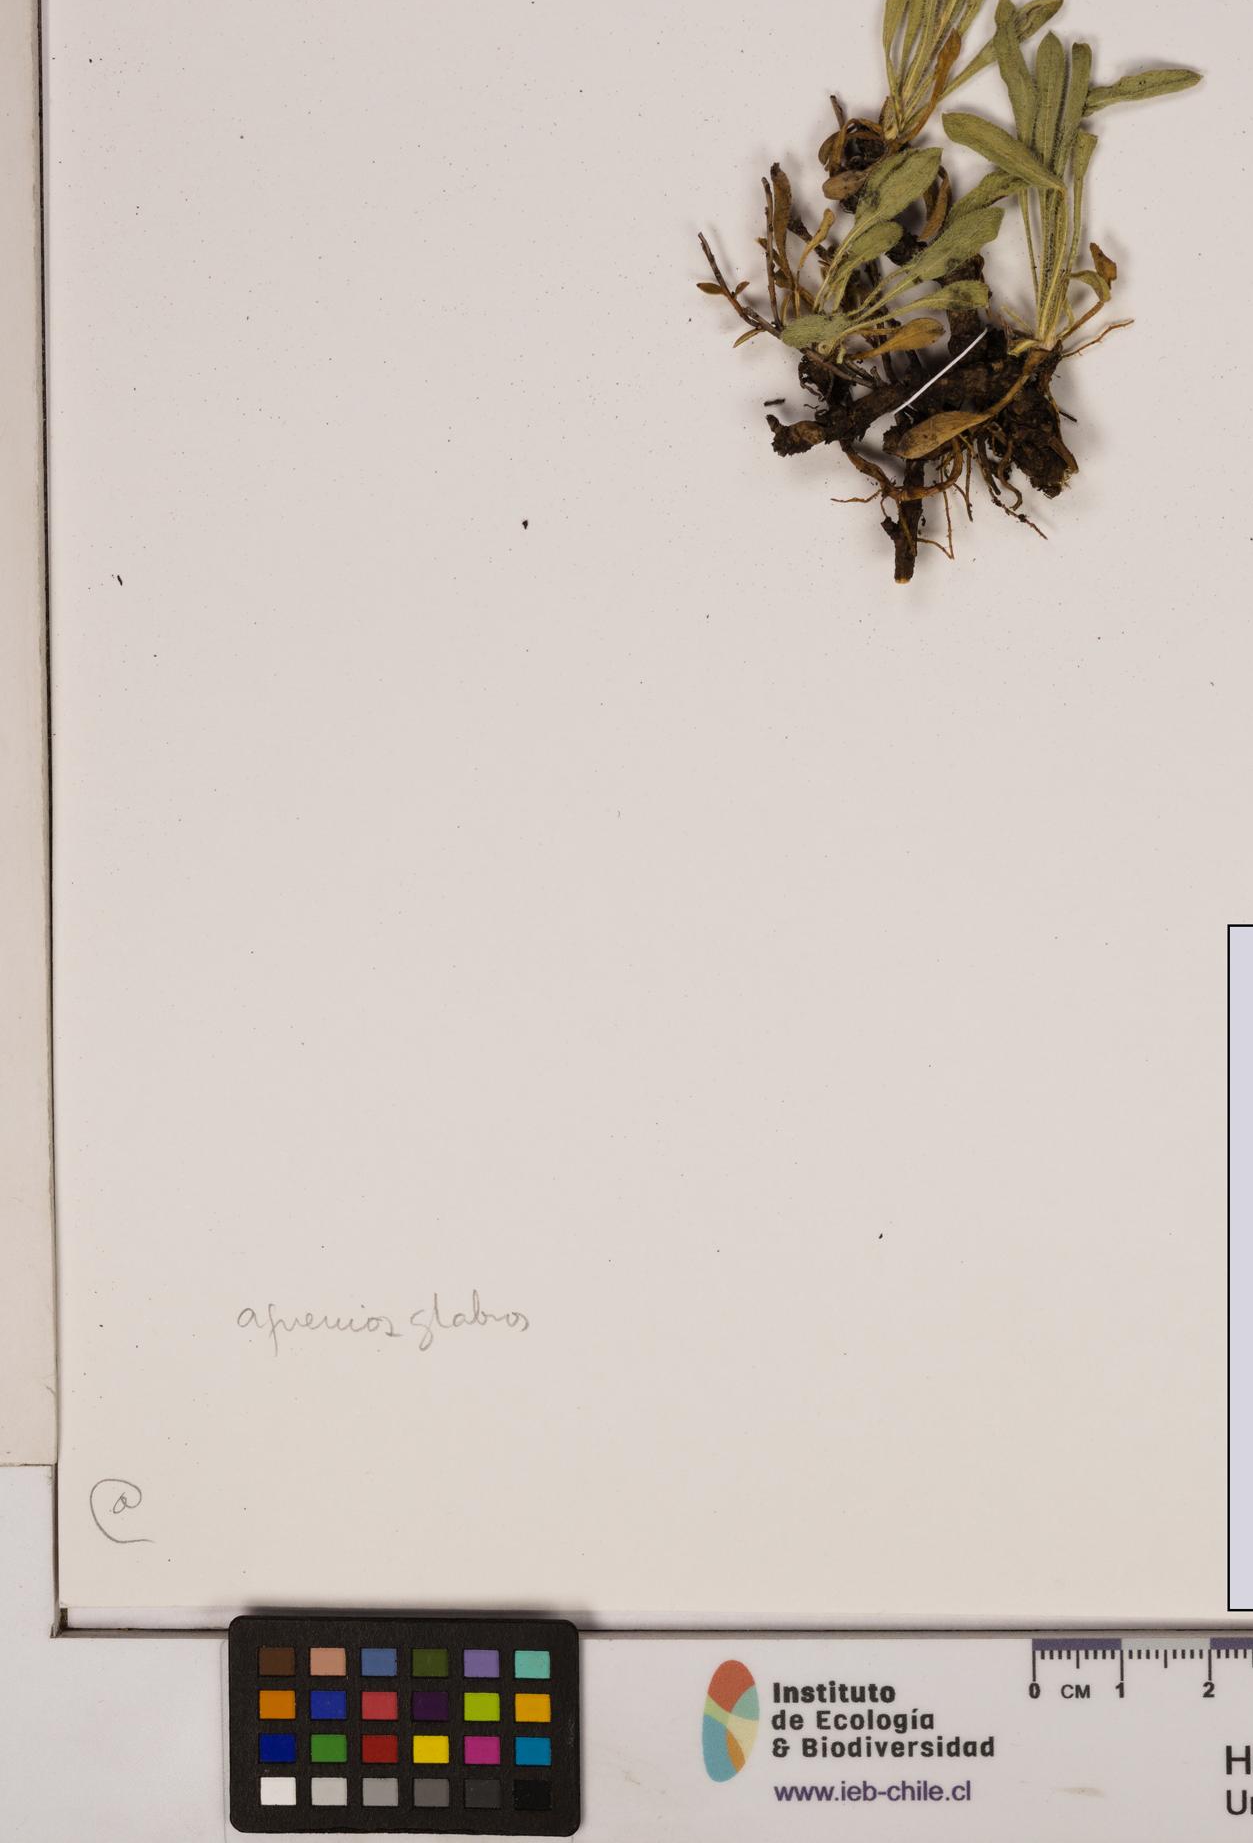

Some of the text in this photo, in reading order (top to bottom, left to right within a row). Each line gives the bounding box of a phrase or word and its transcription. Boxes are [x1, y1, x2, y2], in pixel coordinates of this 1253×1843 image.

[773, 1680, 897, 1704] Instituto
[1028, 1680, 1041, 1700] 0
[1060, 1683, 1092, 1699] CM
[1113, 1680, 1126, 1699] 1
[1202, 1680, 1215, 1698] 2
[771, 1708, 935, 1735] de Ecología
[772, 1735, 996, 1759] & Biodiversidad
[773, 1779, 972, 1803] www.ieb-chile.cl
